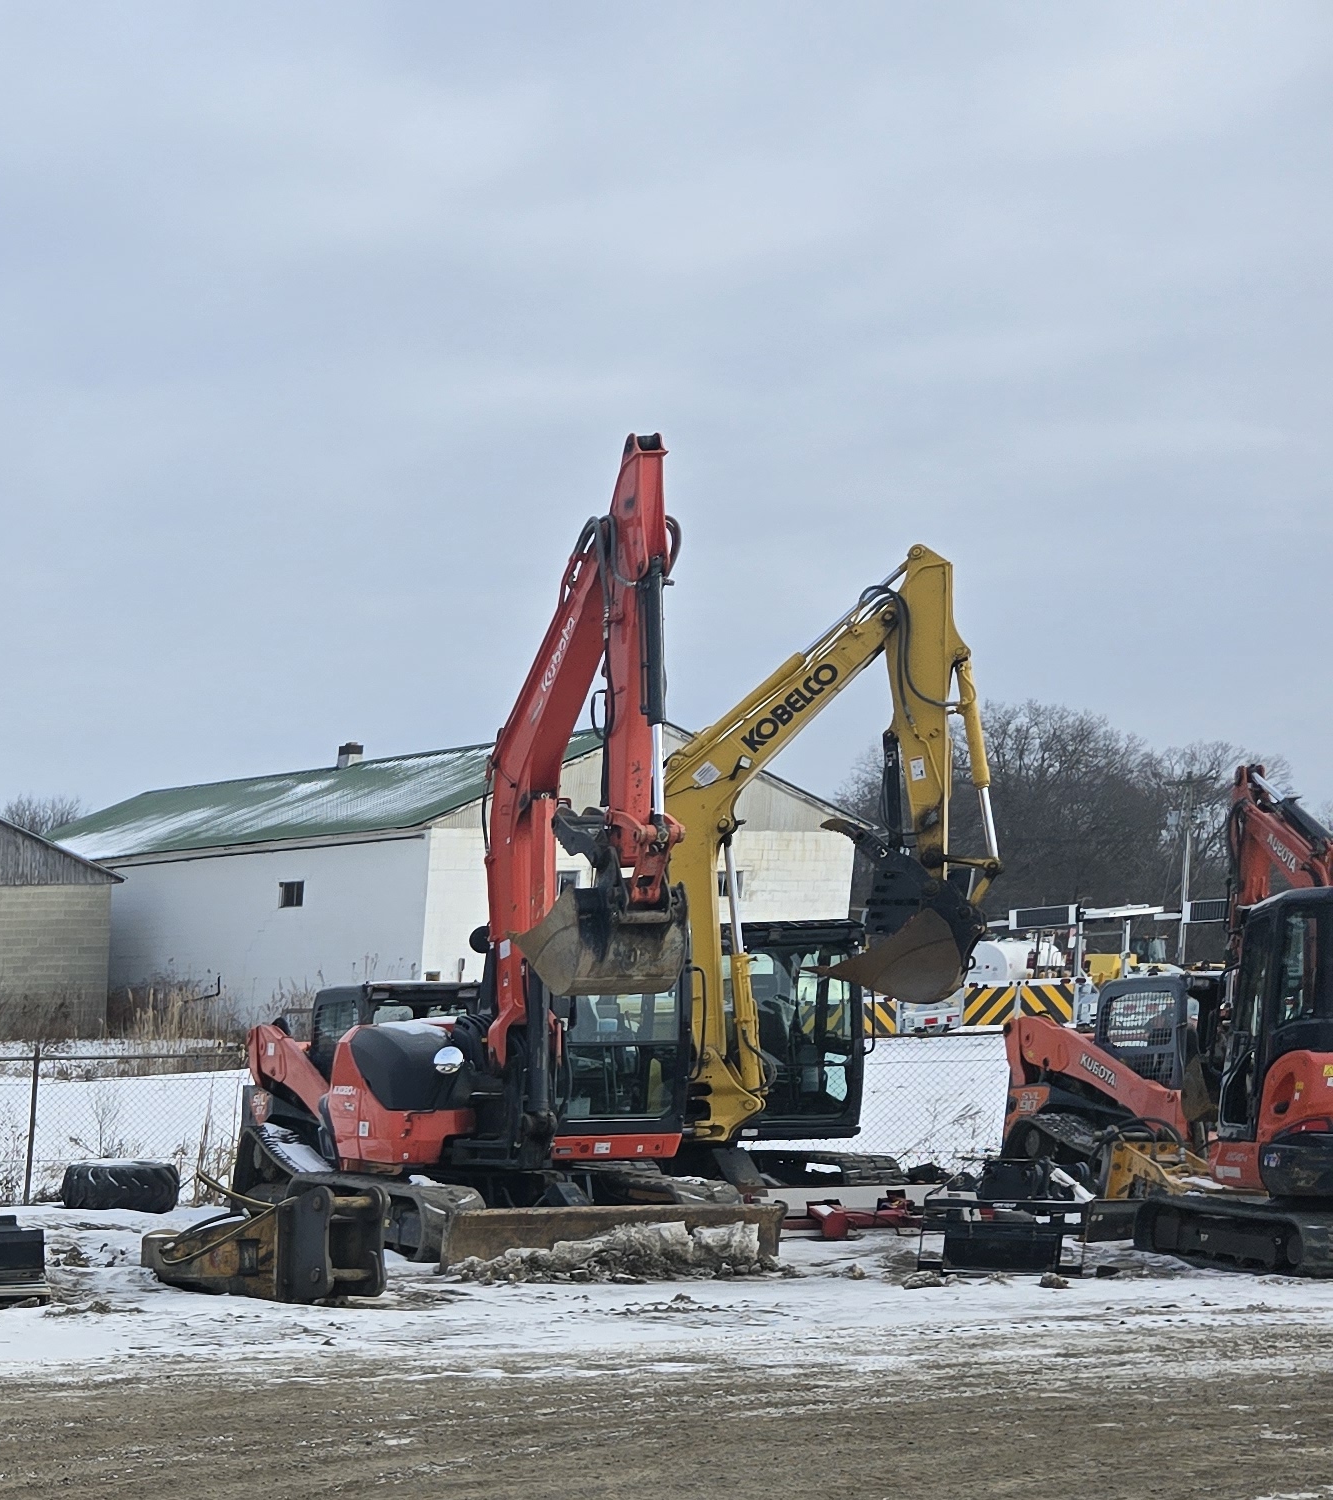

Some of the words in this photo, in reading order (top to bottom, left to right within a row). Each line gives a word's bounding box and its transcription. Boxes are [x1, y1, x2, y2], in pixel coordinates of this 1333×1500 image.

[541, 616, 575, 692] Kubota
[741, 663, 838, 753] KOBELCO
[1021, 1091, 1041, 1100] SVL
[1080, 1053, 1117, 1088] KUBOTA
